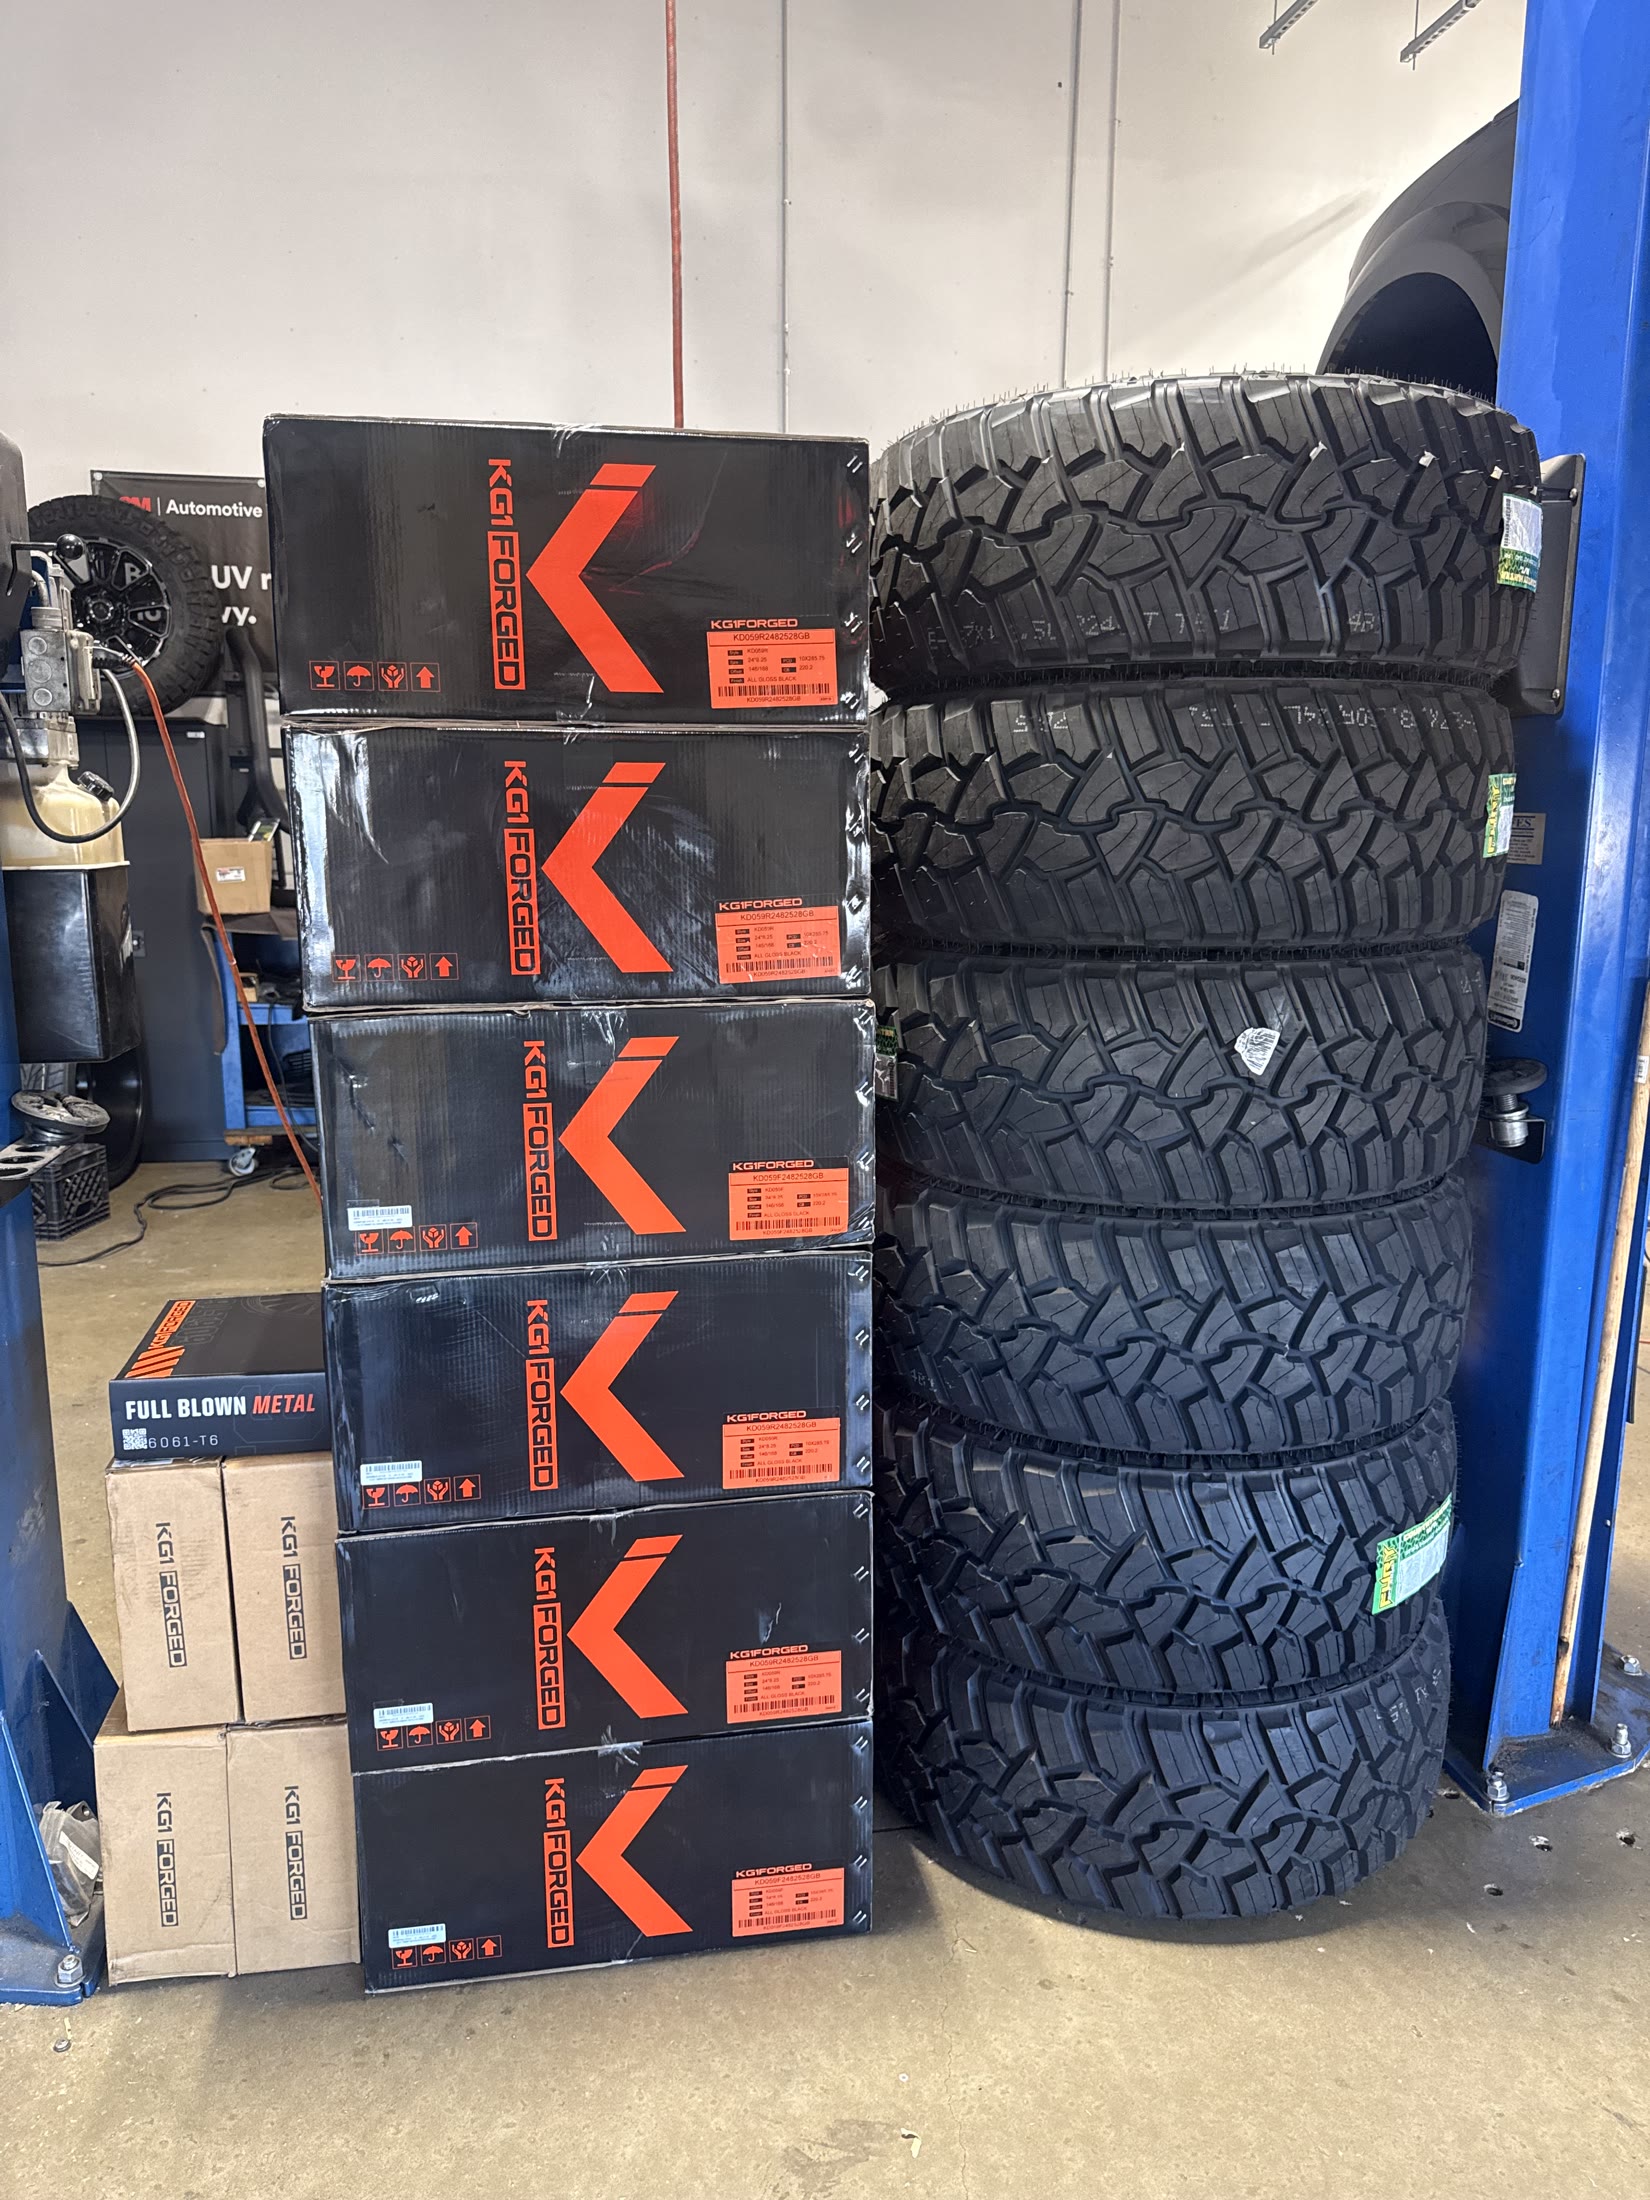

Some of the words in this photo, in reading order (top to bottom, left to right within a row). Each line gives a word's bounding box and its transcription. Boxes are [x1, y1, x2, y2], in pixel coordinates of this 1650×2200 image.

[166, 499, 263, 518] Automotive
[211, 565, 252, 589] UV
[492, 535, 520, 686] FORGED
[711, 619, 798, 629] KG1FORGED
[733, 632, 810, 641] KD059R2482528GB
[509, 832, 535, 972] FORGED
[719, 898, 802, 910] KG1FORGED
[741, 910, 814, 920] KD059R2482528GB
[527, 1107, 552, 1237] FORGED
[733, 1160, 814, 1170] KG1FORGED
[753, 1173, 824, 1181] KD059F2482528GB
[126, 1400, 172, 1420] FULL
[178, 1396, 246, 1417] BLOWN
[253, 1394, 315, 1414] METAL
[530, 1362, 553, 1486] FORGED
[727, 1411, 806, 1422] KG1FORGED
[746, 1422, 816, 1431] KD059R2482528GB
[149, 1435, 219, 1448] 6061-T6
[156, 1523, 175, 1564] KG1
[281, 1516, 298, 1557] KG1
[1379, 1546, 1397, 1609] FURY
[160, 1572, 186, 1666] FORGED
[284, 1565, 306, 1659] FORGED
[538, 1607, 561, 1725] FORGED
[730, 1645, 808, 1659] KG1FORGED
[157, 1793, 173, 1832] KG1
[285, 1786, 300, 1825] KG1
[158, 1840, 177, 1926] FORGED
[286, 1832, 306, 1919] FORGED
[548, 1834, 569, 1944] FORGED
[736, 1863, 812, 1878] KG1FORGED
